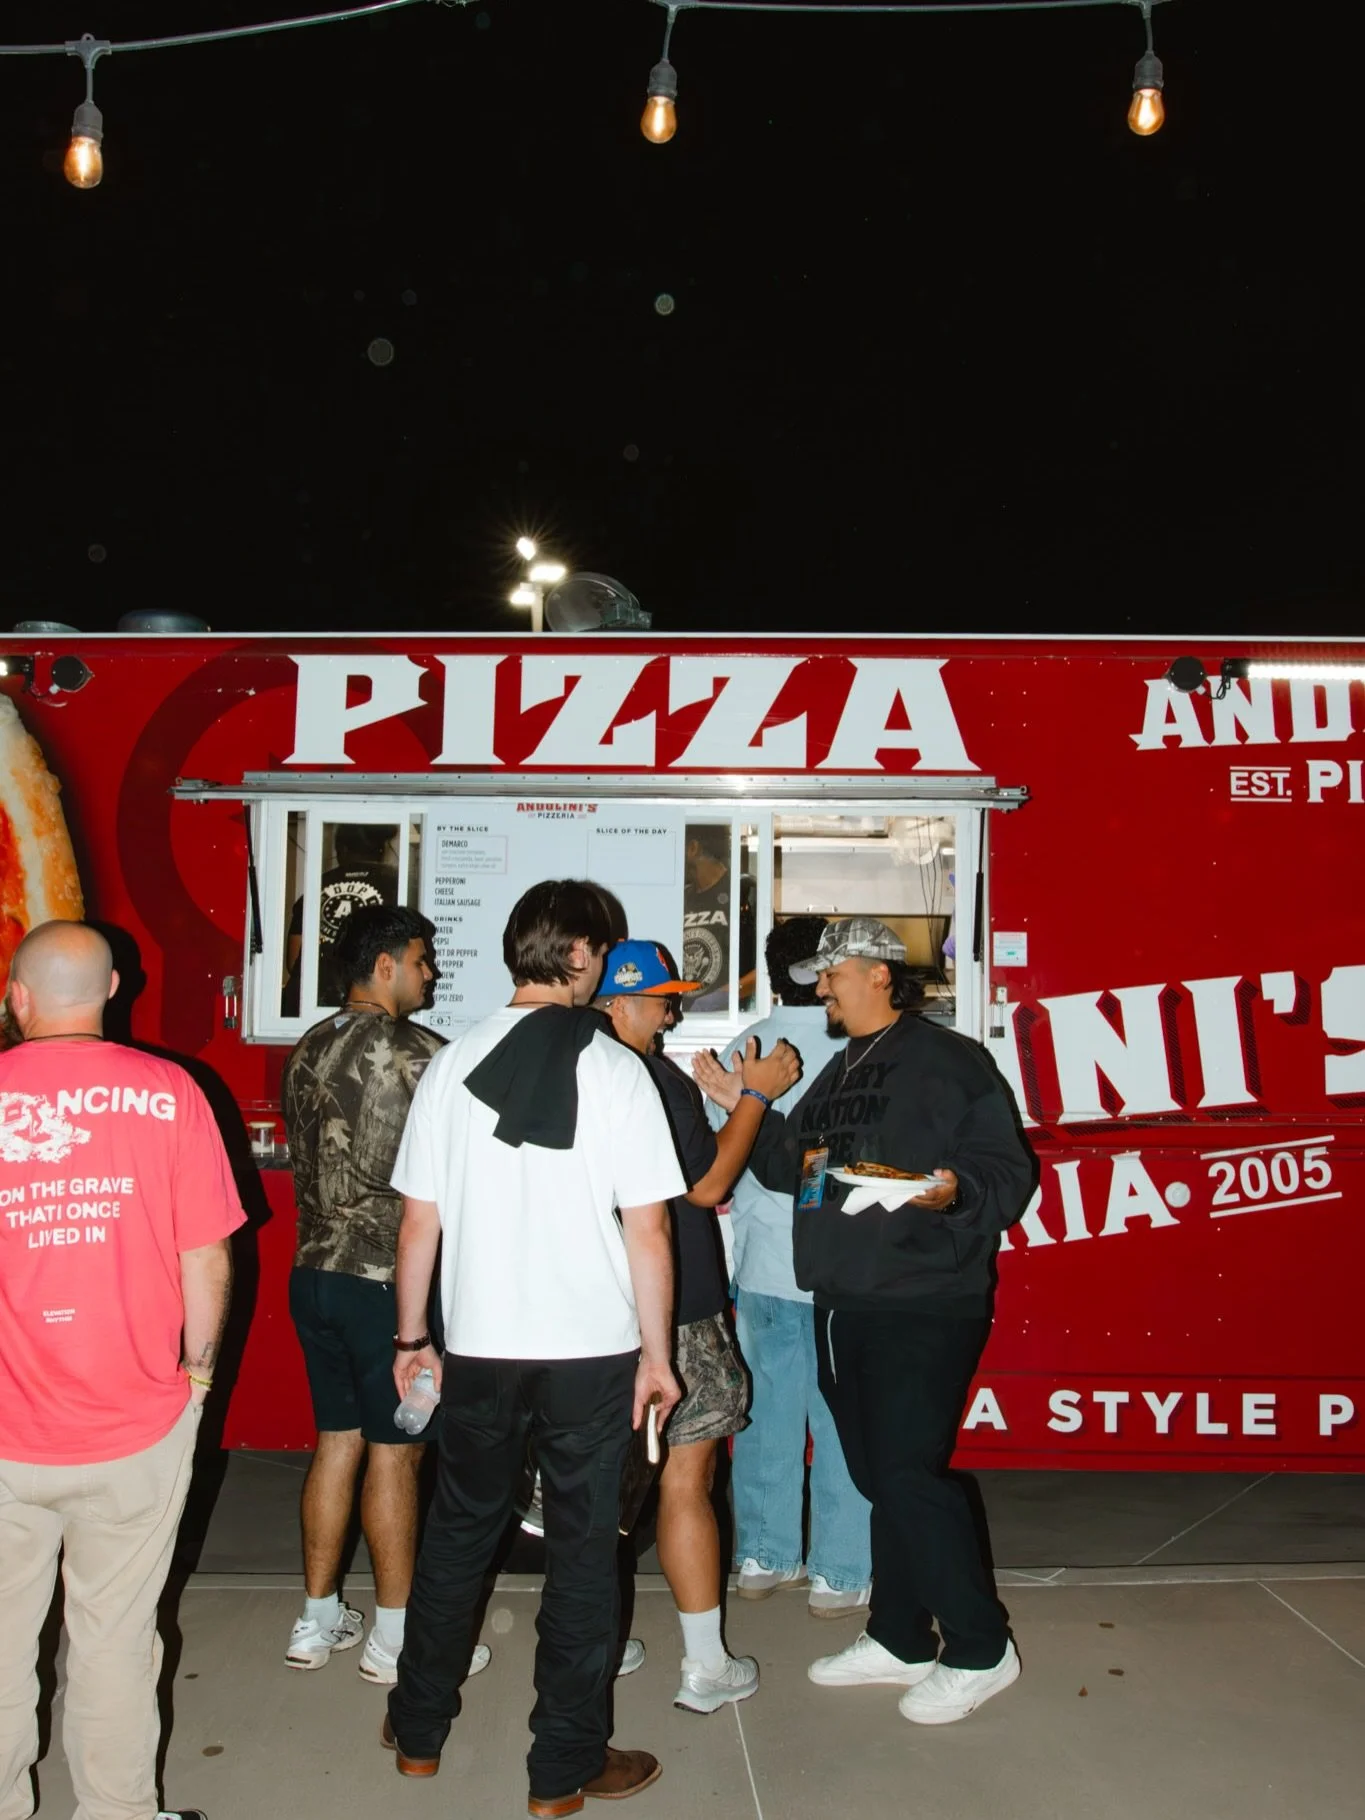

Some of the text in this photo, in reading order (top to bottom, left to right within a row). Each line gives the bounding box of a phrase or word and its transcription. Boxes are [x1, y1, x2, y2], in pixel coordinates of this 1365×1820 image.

[281, 654, 983, 771] PIZZA
[1129, 675, 1365, 751] AND
[1230, 759, 1365, 804] EST. PI
[516, 802, 599, 813] ANDOLINI'S
[537, 812, 575, 820] PIZZERIA
[651, 828, 668, 836] DAY
[441, 839, 469, 848] DEMARCO
[434, 876, 467, 885] PEPPERONI
[434, 887, 455, 896] CHEESE
[434, 897, 481, 907] ITALIAN SAUSAGE
[435, 926, 454, 934] WATER
[433, 936, 450, 945] PEPSI
[446, 948, 455, 957] DR
[456, 948, 478, 957] PEPPER
[442, 960, 464, 968] PEPPER
[435, 982, 454, 991] ARRY
[448, 993, 464, 1002] ZERO
[800, 1094, 890, 1132] NATION
[1208, 1147, 1333, 1206] 2005
[0, 1177, 135, 1207] ON THE GRAVE
[6, 1204, 56, 1229] THAT
[66, 1201, 121, 1220] ONCE
[28, 1226, 106, 1249] LIVED IN
[1047, 1390, 1277, 1435] STYLE
